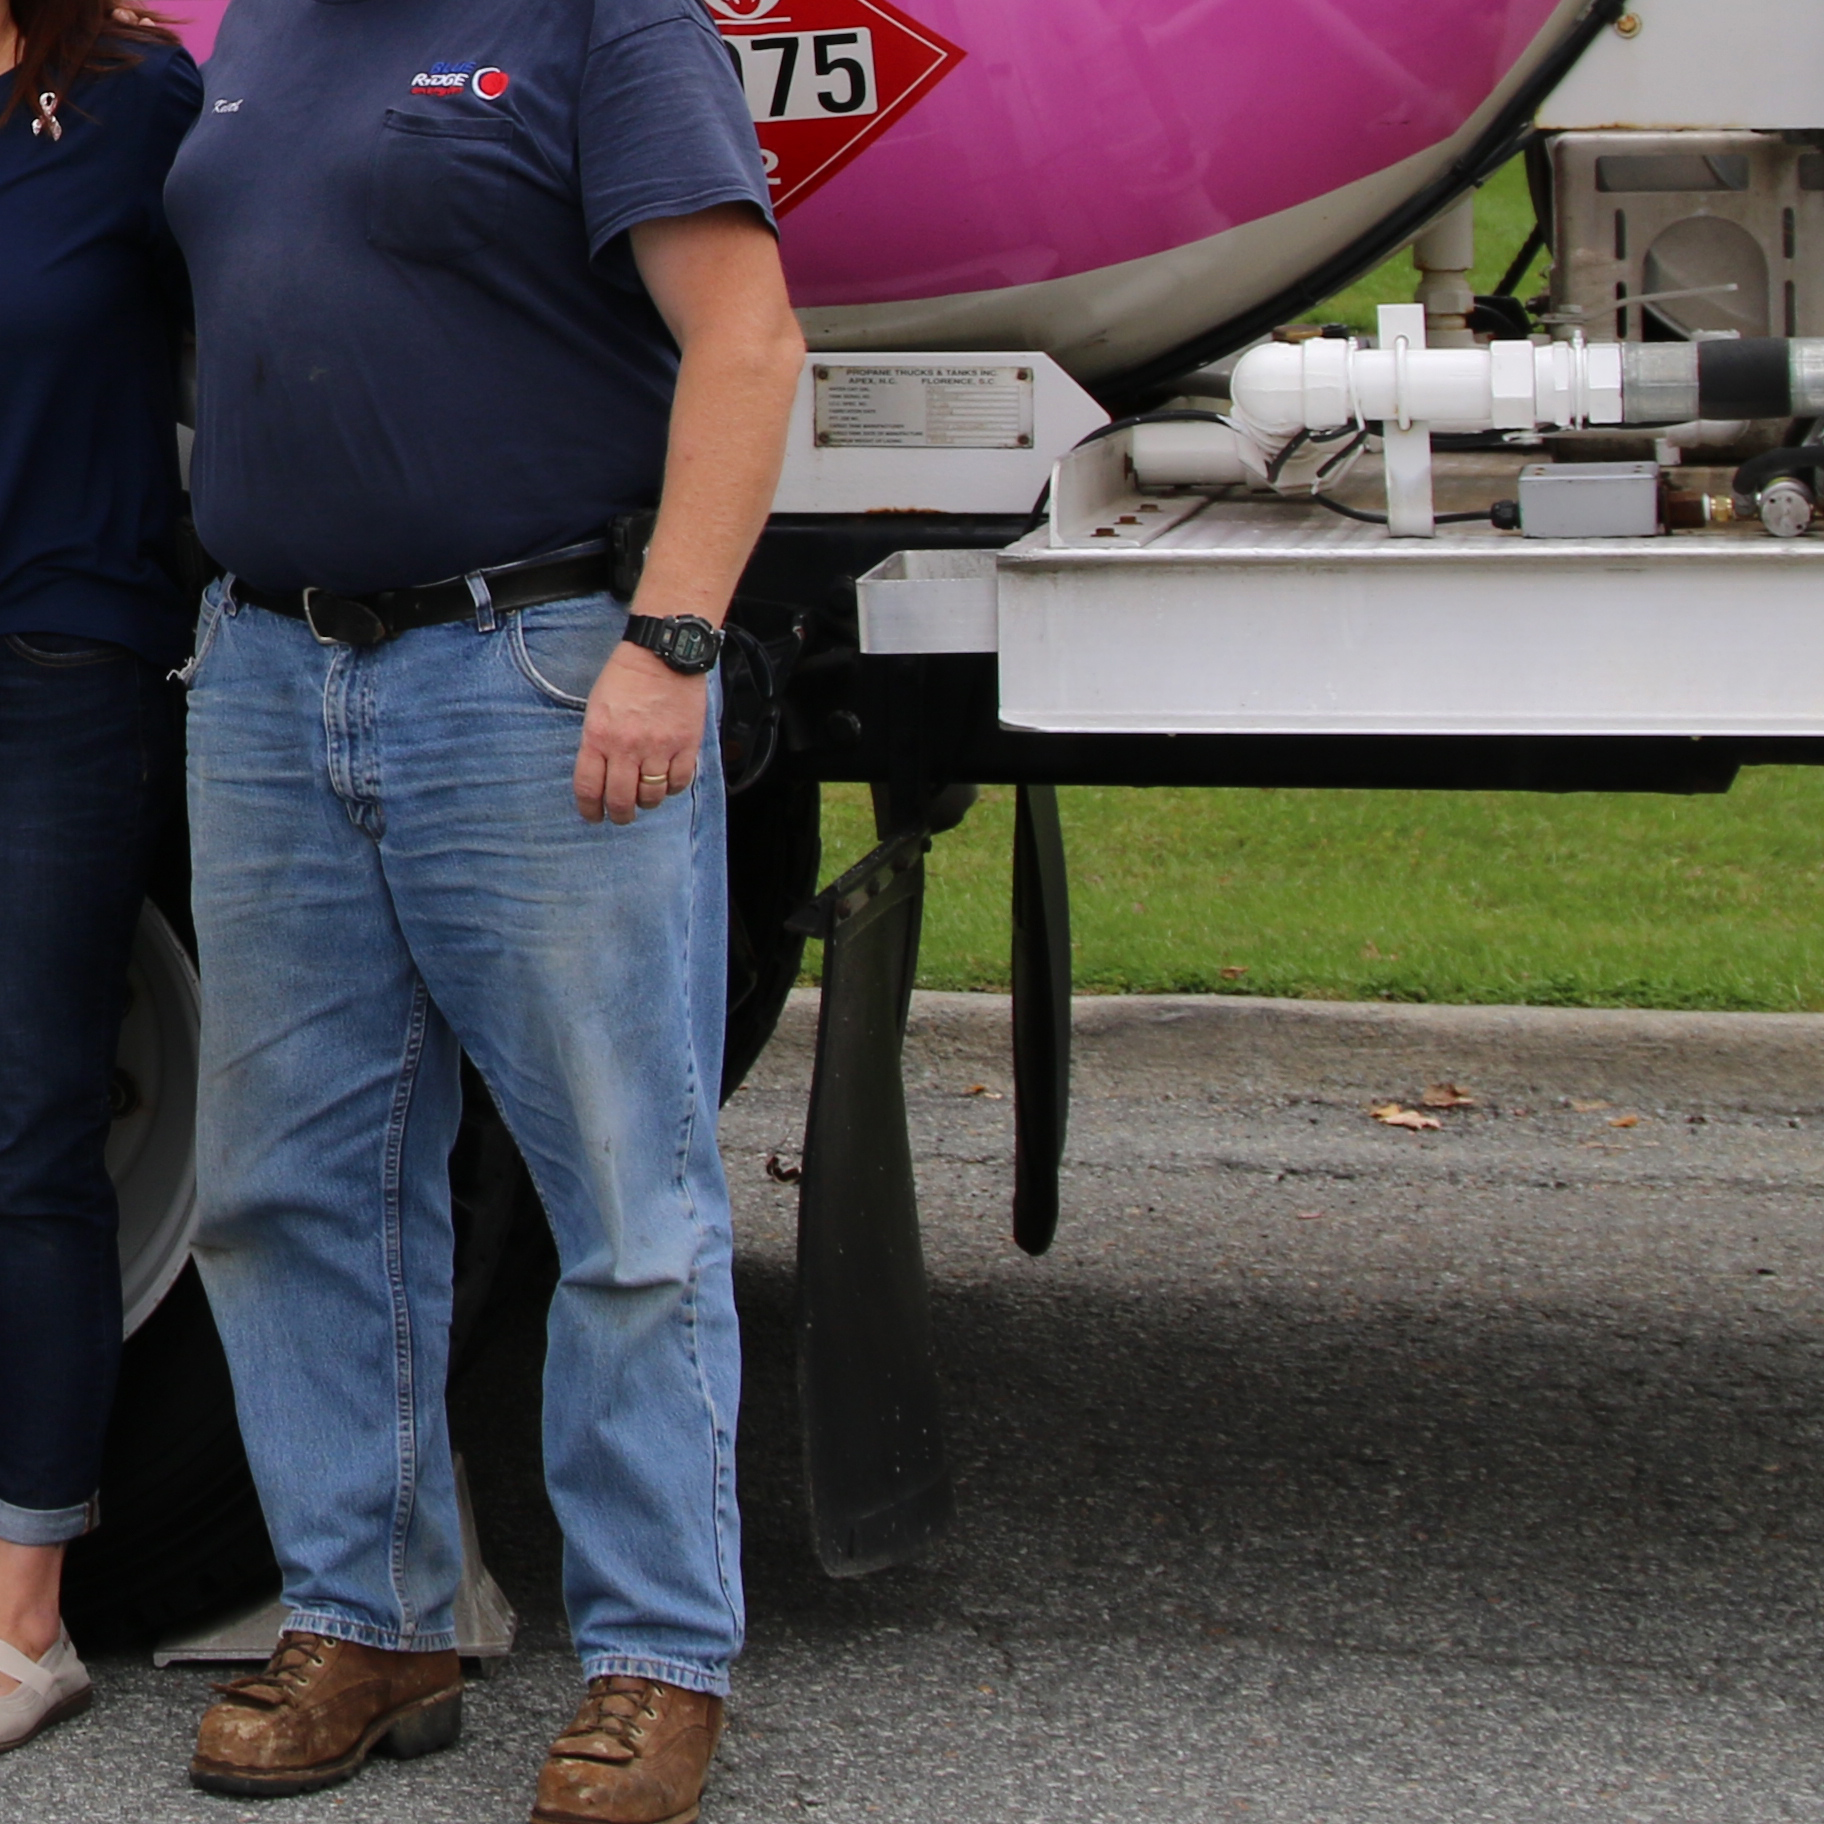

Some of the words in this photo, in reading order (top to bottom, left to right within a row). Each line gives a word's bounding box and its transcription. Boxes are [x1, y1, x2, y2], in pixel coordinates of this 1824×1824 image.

[431, 61, 476, 74] BLUE
[411, 73, 469, 87] RIDGE
[846, 369, 891, 377] PROPANE
[895, 369, 935, 377] TRUCKS
[946, 369, 979, 377] TANKS
